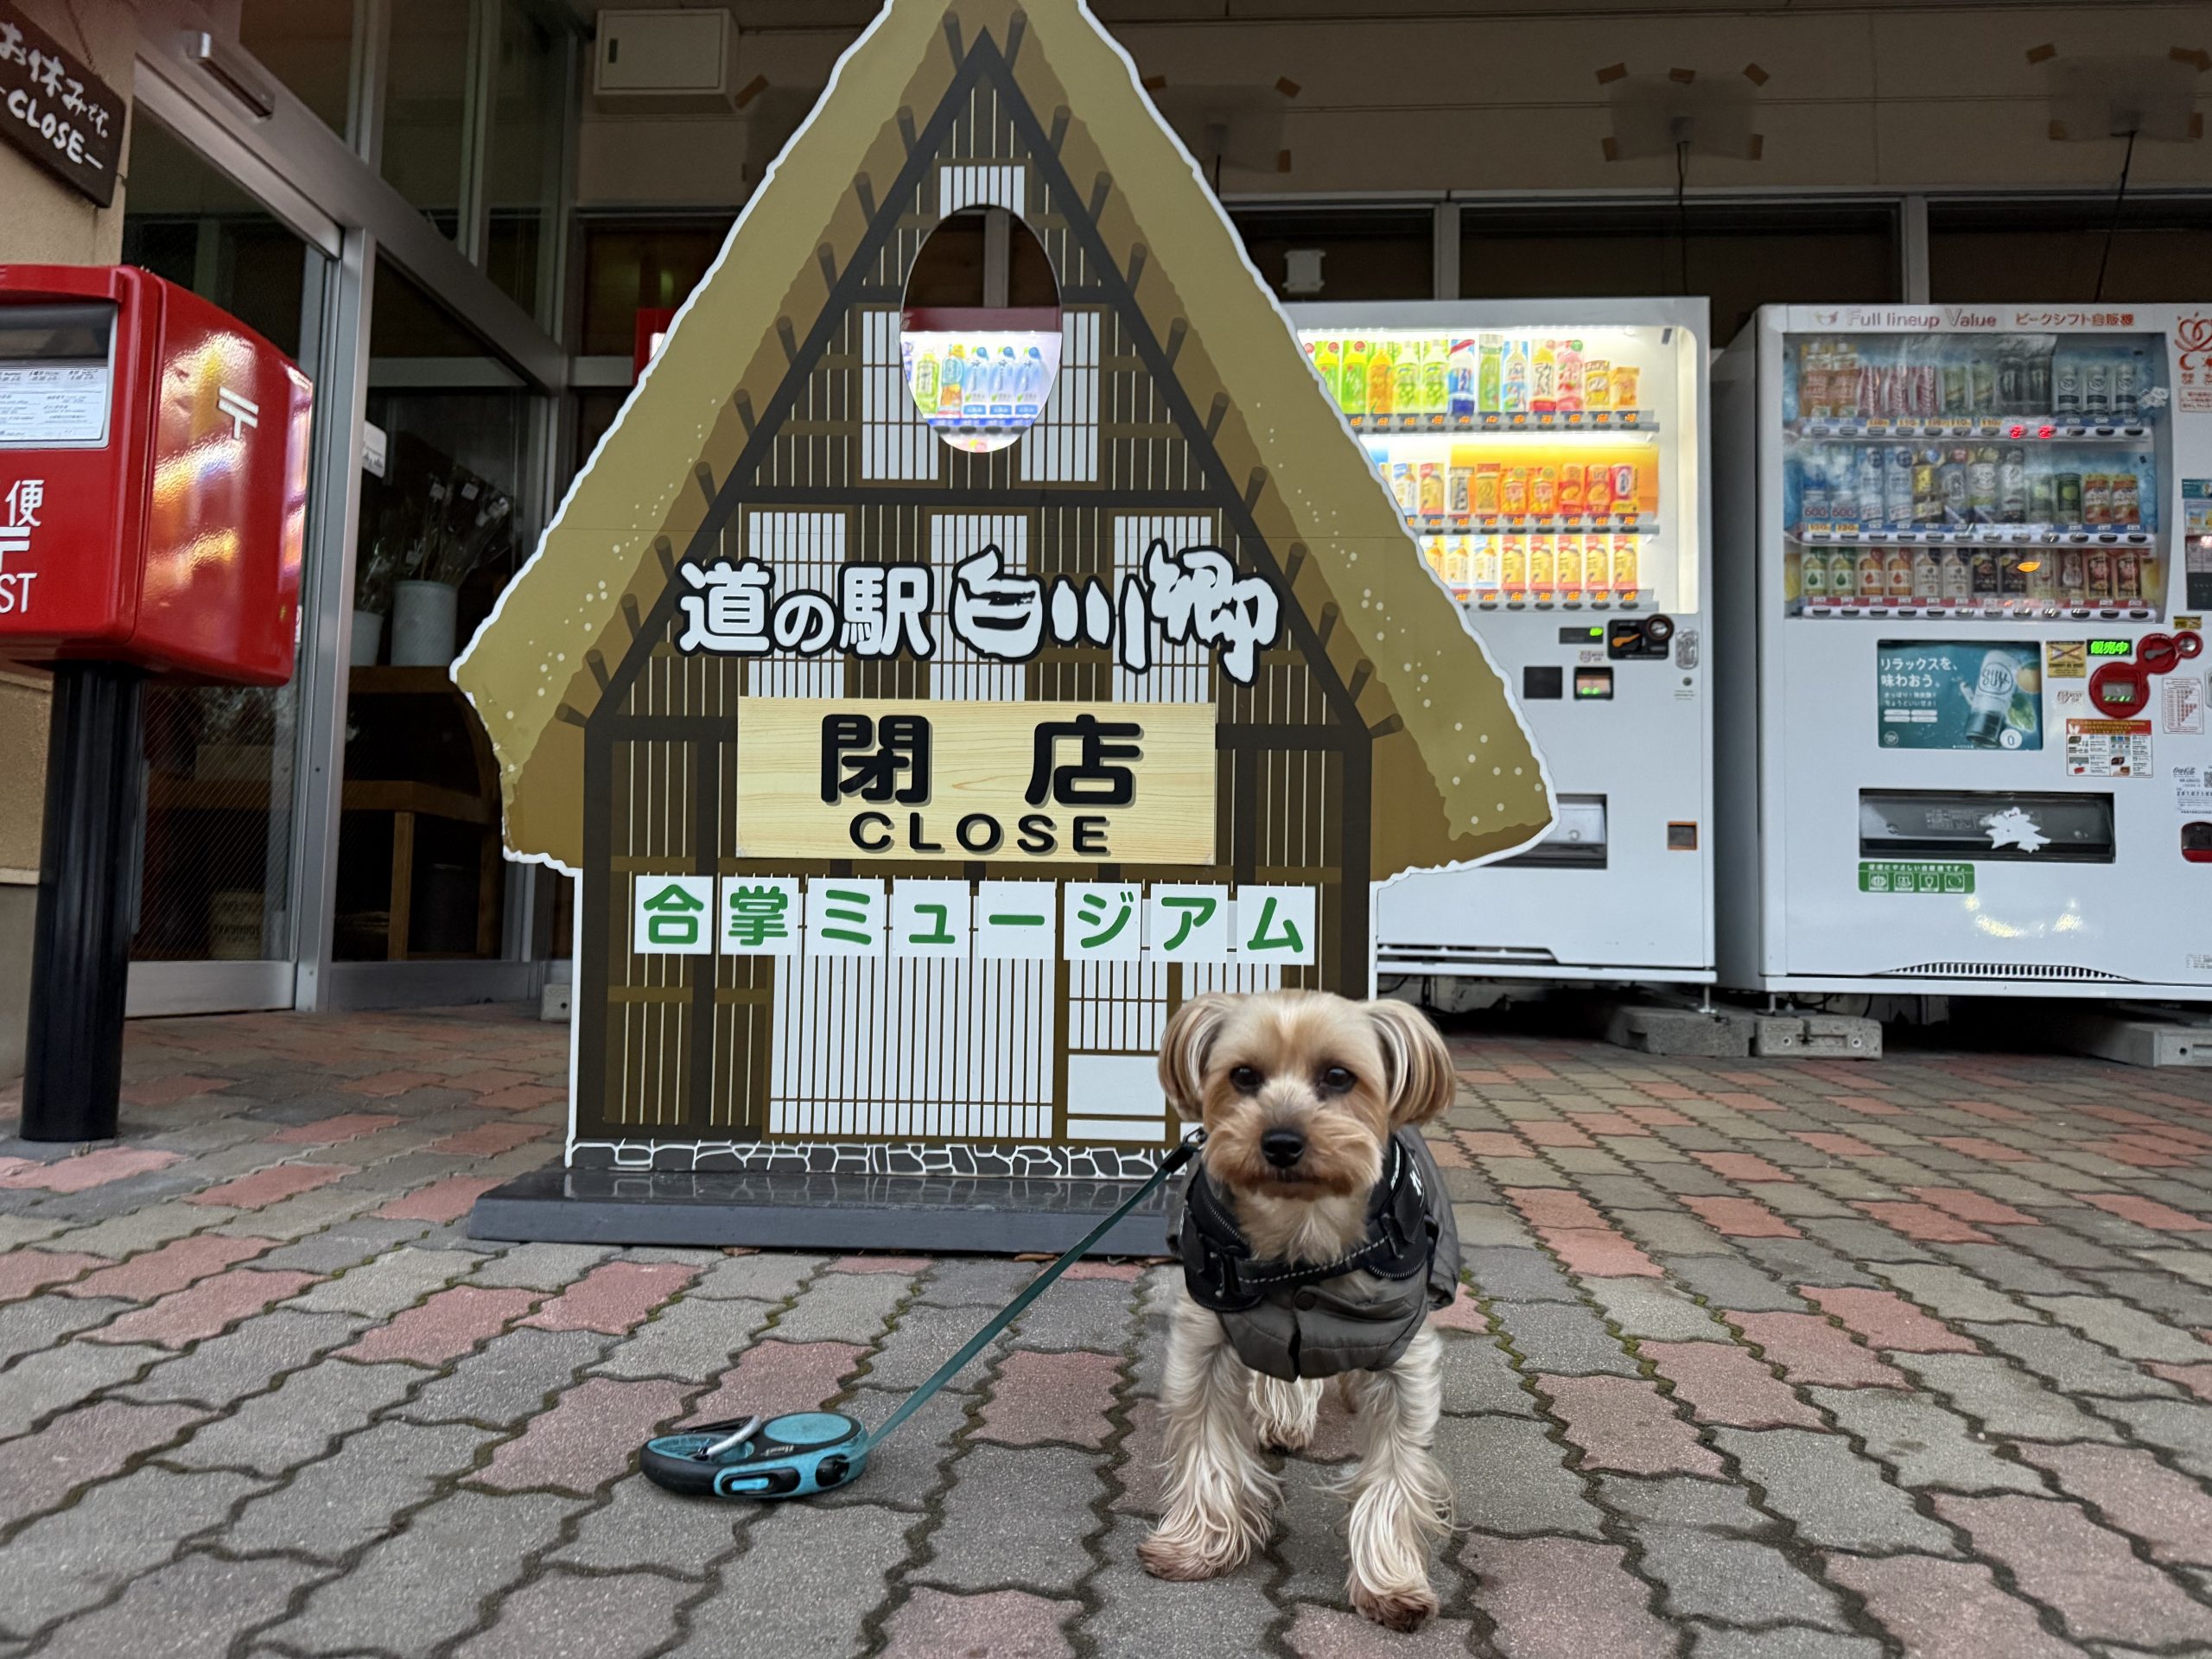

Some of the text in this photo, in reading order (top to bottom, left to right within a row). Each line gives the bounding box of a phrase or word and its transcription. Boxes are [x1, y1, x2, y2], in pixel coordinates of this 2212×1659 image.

[1846, 307, 1997, 329] Full lineup Value
[5, 479, 45, 527] 便
[1880, 658, 1957, 671] リラックスを、
[1880, 673, 1941, 689] 味わおう。
[822, 714, 1142, 806] 閉店
[849, 811, 1110, 855] CLOSE
[643, 884, 1304, 953] 合掌ミュージアム
